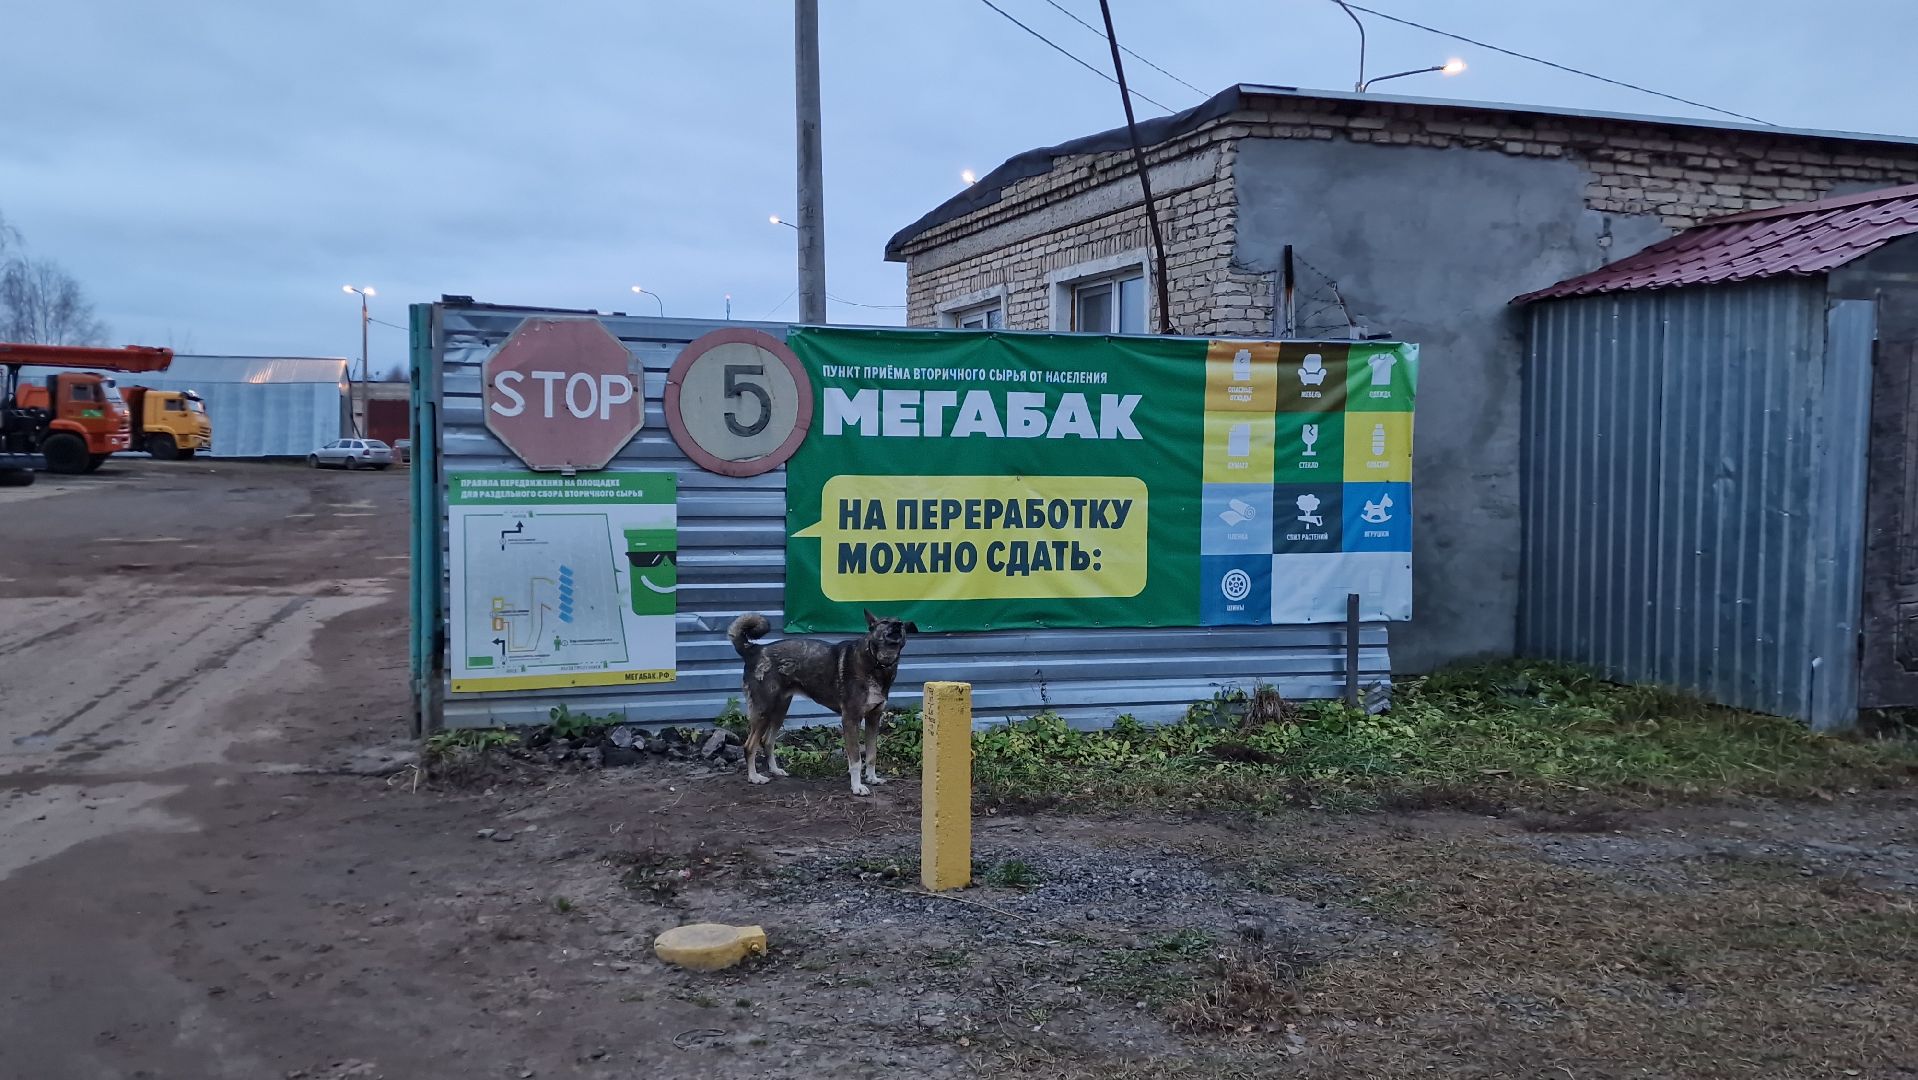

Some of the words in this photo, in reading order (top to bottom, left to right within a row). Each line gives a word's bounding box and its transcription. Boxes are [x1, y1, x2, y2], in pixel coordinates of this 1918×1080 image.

[823, 365, 860, 379] ПУНКТ
[864, 365, 910, 380] ПРИЁМА
[913, 367, 986, 381] ВТОРИЧНОГО
[989, 369, 1027, 382] СЫРЬЯ
[1030, 371, 1043, 383] ОТ
[1046, 370, 1107, 384] НАСЕЛЕНИЯ
[491, 370, 633, 420] STOP
[724, 365, 772, 437] 5
[823, 387, 1144, 440] МЕГАБАК
[461, 479, 499, 487] ПРАВИЛА
[500, 479, 563, 488] ПЕРЕДВИЖЕНИЯ
[565, 479, 576, 487] НА
[577, 479, 620, 488] ПЛОЩАДКЕ
[461, 490, 478, 499] ДЛЯ
[479, 490, 536, 498] РАЗДЕЛЬНОГО
[537, 490, 564, 498] СБОРА
[565, 489, 614, 498] ВТОРИЧНОГО
[616, 489, 643, 497] СЫРЬЯ
[838, 499, 886, 530] НА
[896, 498, 1133, 530] ПЕРЕРАБОТКУ
[1302, 532, 1329, 541] РАСТЕНИЙ
[1364, 530, 1390, 538] ИГРУШКИ
[837, 541, 978, 575] МОЖНО
[986, 540, 1102, 577] СДАТЬ:
[1226, 604, 1245, 612] ШИНЫ
[624, 671, 670, 681] МЕГАБАК.РФ
